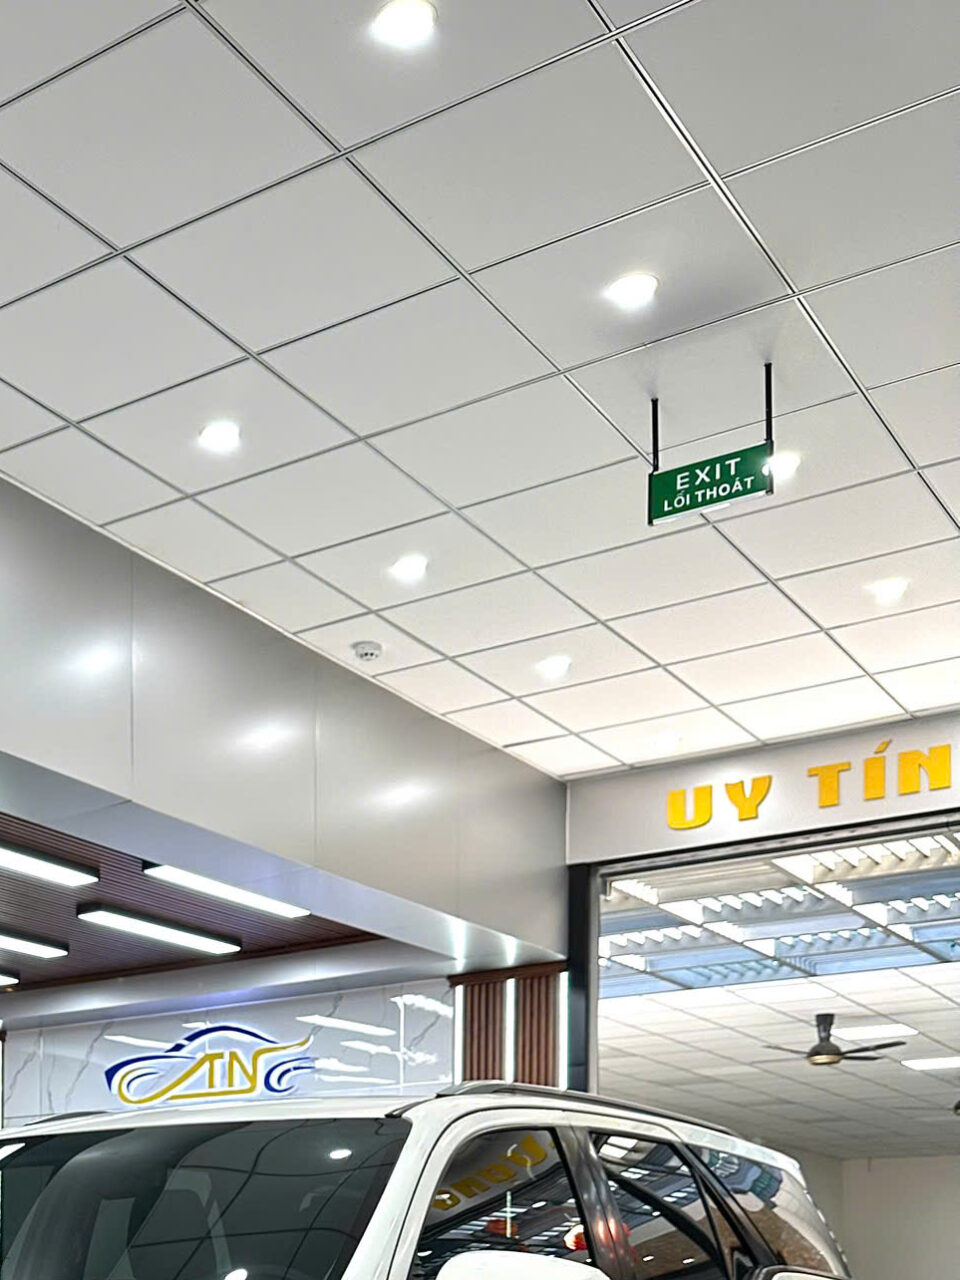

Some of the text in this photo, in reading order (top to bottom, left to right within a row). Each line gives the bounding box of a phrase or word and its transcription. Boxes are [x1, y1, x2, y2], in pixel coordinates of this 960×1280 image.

[676, 458, 741, 491] EXIT
[695, 476, 755, 503] THOÁT
[666, 739, 951, 830] UY TÍN
